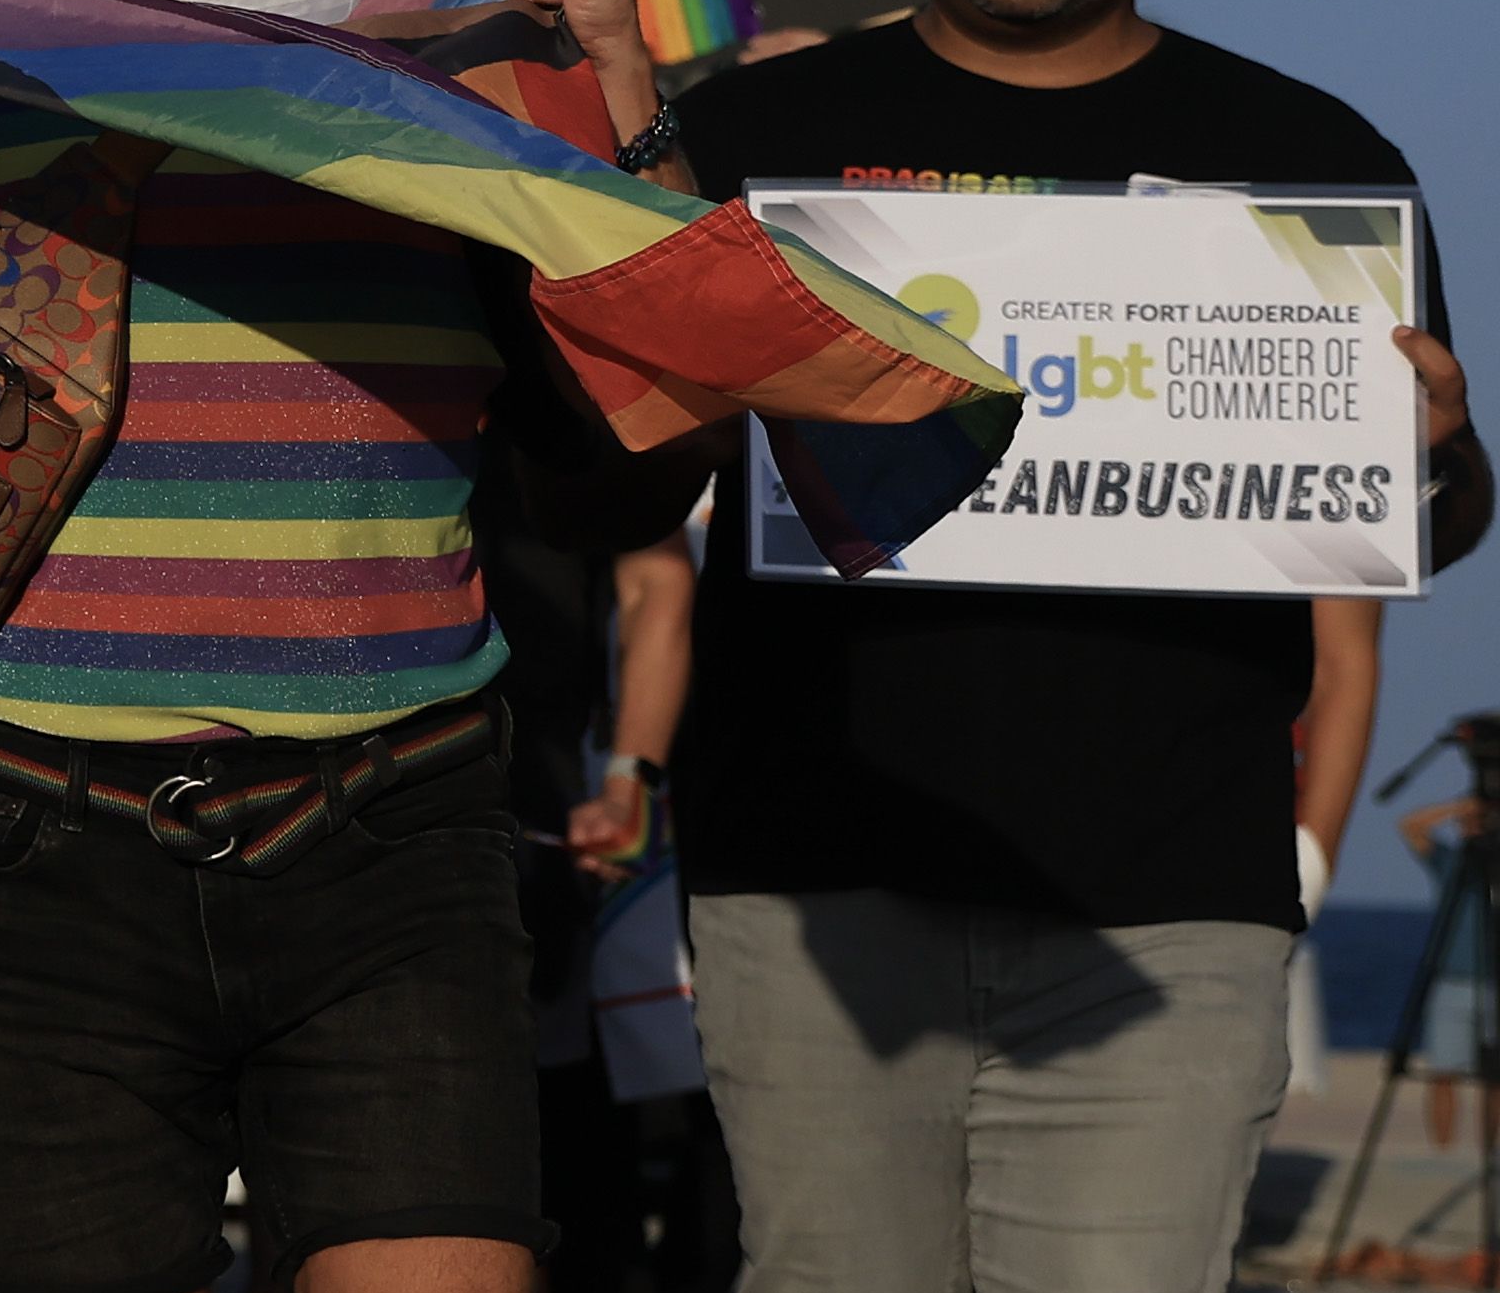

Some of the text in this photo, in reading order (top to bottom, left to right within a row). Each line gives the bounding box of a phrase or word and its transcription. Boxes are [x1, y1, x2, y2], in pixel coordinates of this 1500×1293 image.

[1001, 300, 1361, 324] GREATER FORT LAUDERDALE
[1166, 336, 1362, 379] CHAMBER OF
[1166, 380, 1361, 422] COMMERCE
[952, 458, 1392, 524] EANBUSINESS
